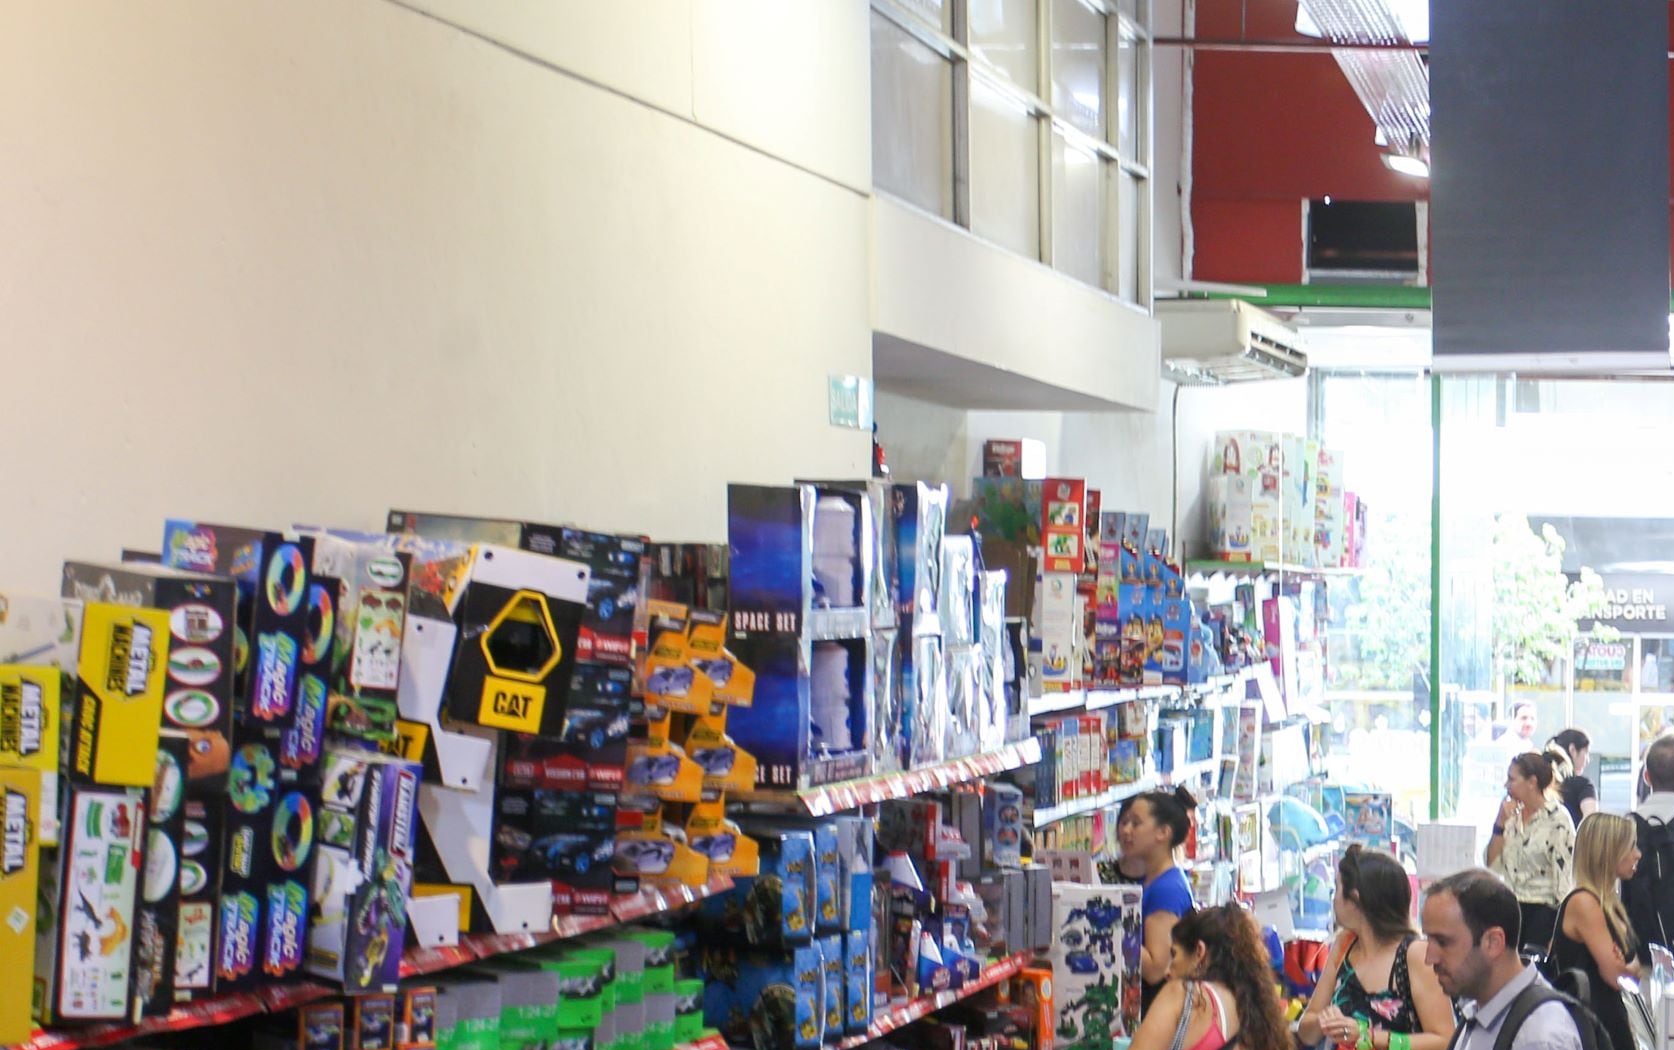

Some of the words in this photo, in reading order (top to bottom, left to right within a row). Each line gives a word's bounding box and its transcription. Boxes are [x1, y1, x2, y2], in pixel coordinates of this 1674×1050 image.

[734, 611, 770, 632] SPACE
[776, 611, 797, 633] SET
[1583, 603, 1667, 621] ANSPORTE
[1632, 589, 1654, 604] EN
[127, 619, 151, 695] METAL
[272, 631, 295, 706] Magic
[20, 677, 42, 755] METAL
[492, 690, 533, 720] CAT
[771, 764, 792, 784] SET
[3, 791, 27, 874] METAL
[235, 891, 257, 964] Magic
[282, 880, 306, 960] Magic
